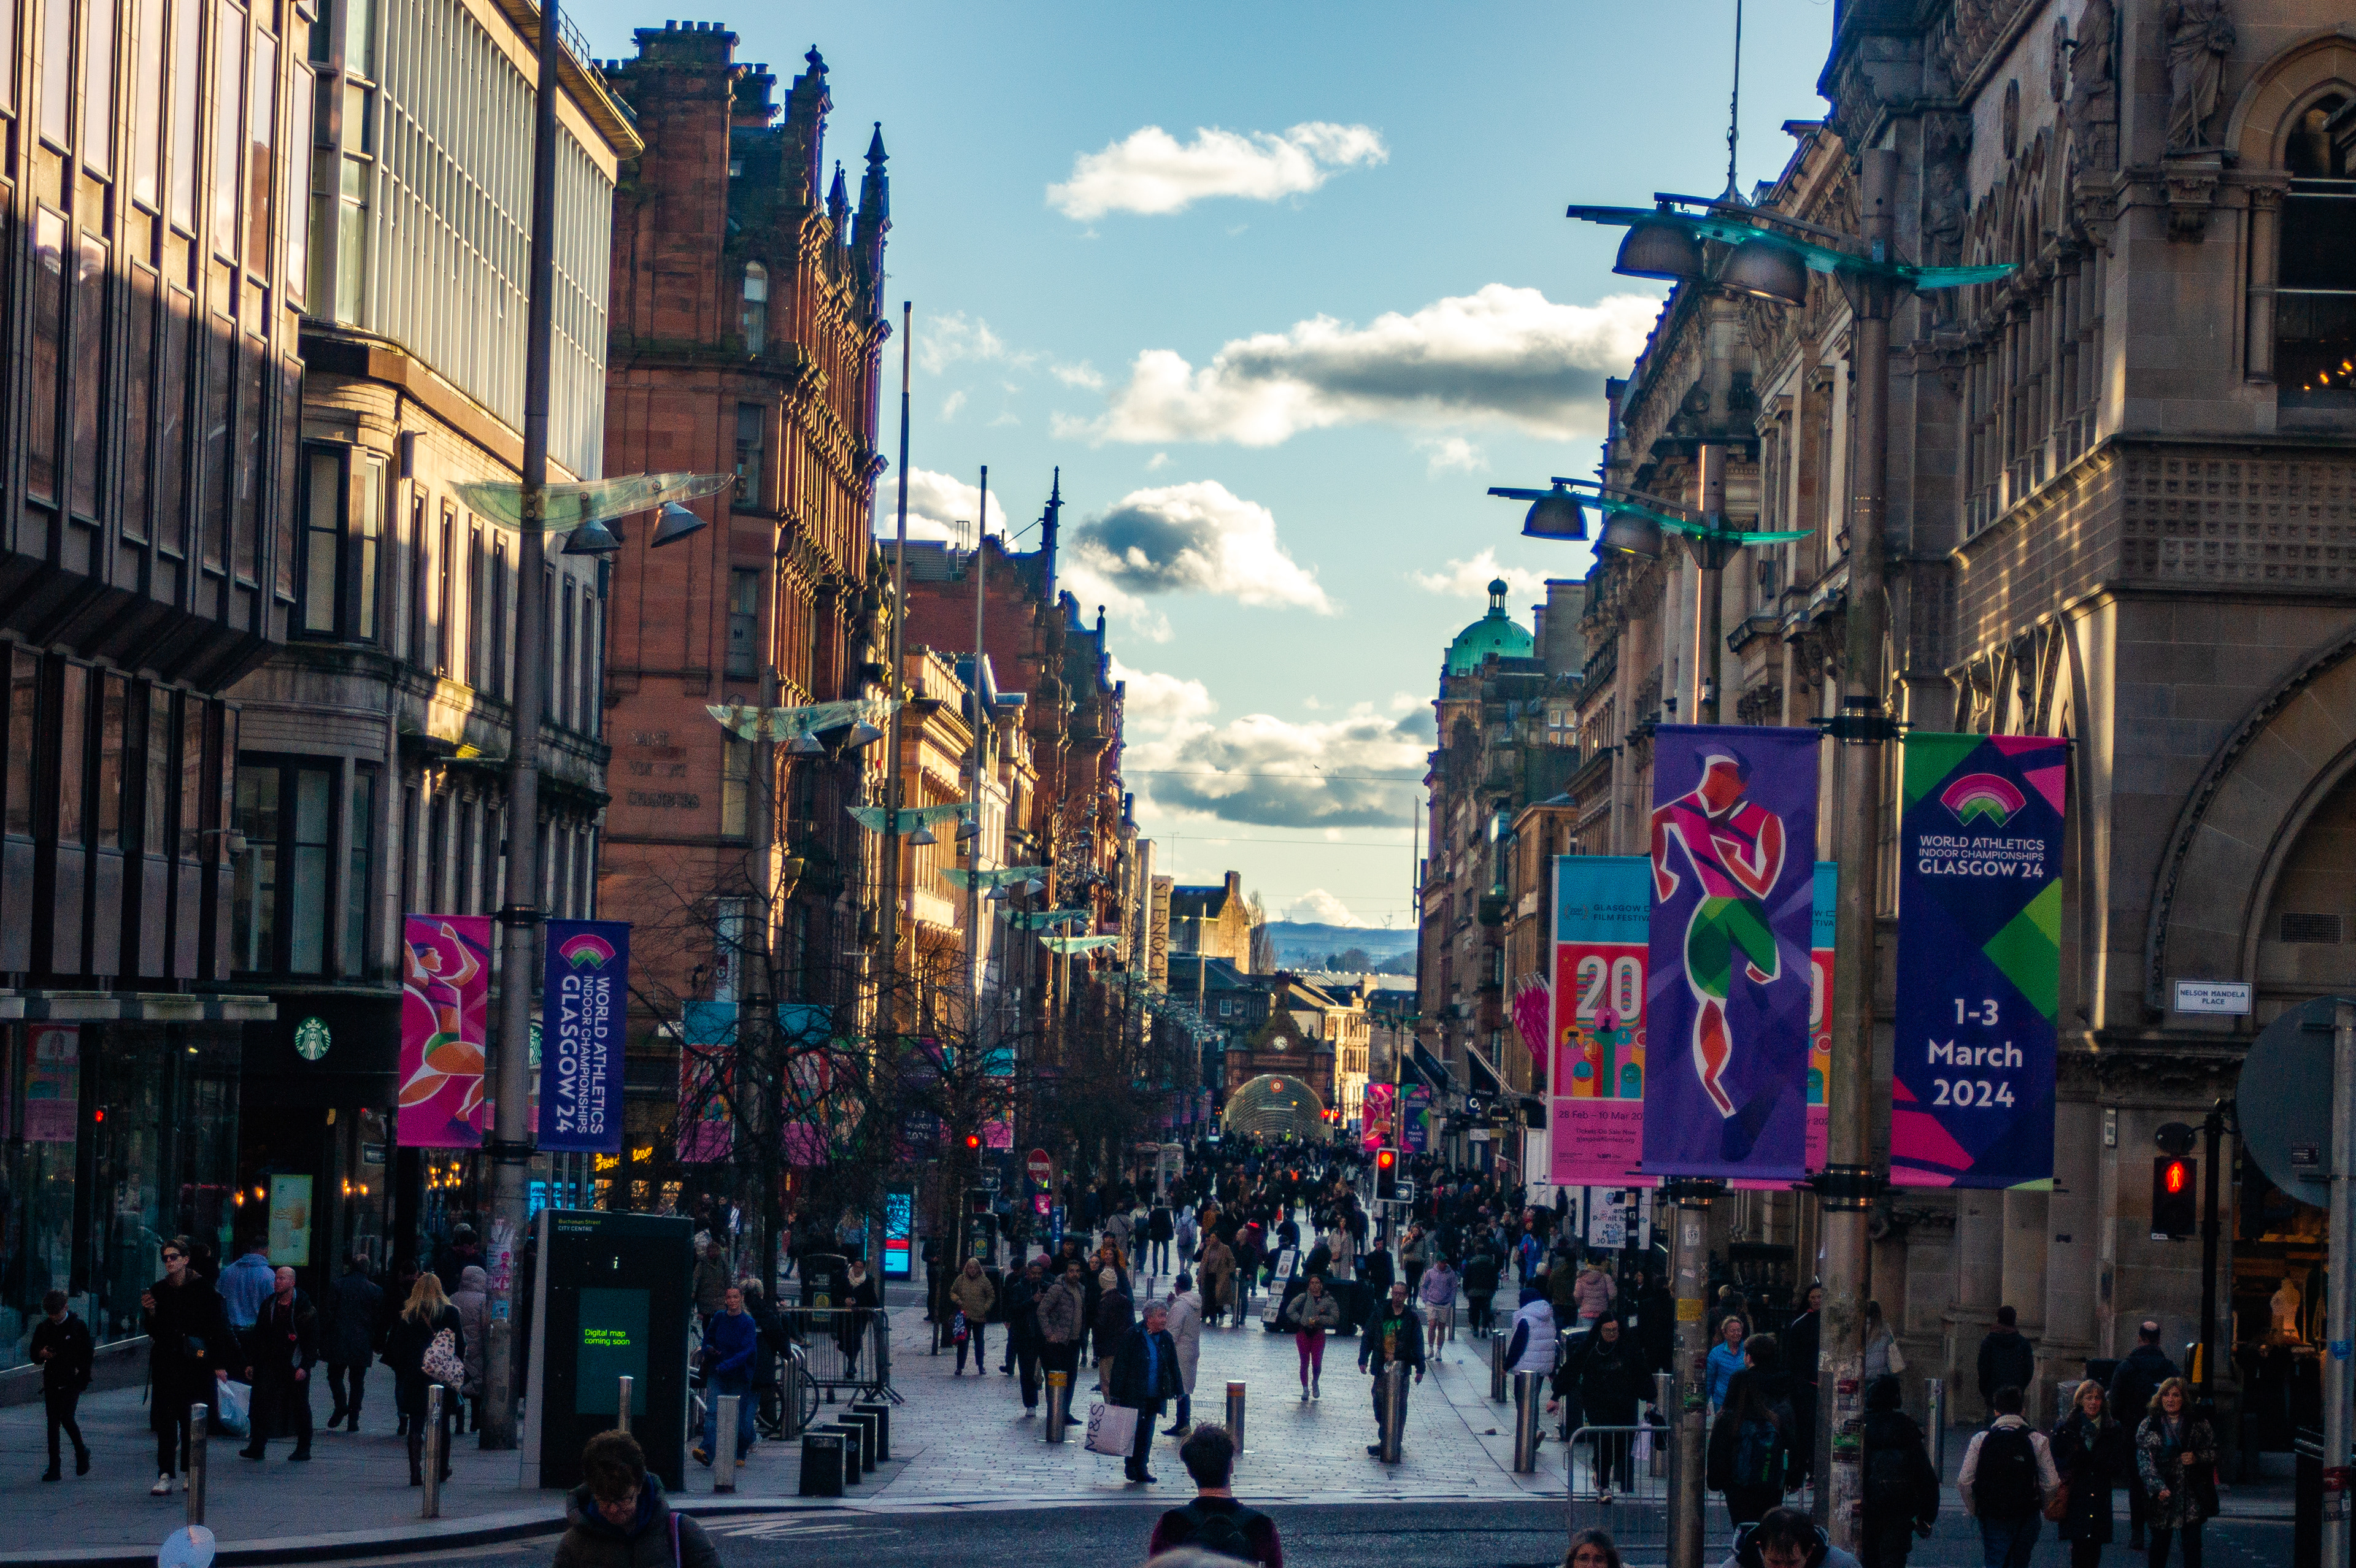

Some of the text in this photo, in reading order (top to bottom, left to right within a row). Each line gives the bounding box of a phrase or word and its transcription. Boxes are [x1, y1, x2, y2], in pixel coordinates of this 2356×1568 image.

[1919, 848, 2044, 861] INDOOR CHAMPIONSHIPS
[1920, 835, 2045, 850] WORLD ATHLETICS
[1919, 860, 2044, 878] GLASGOW 24
[1593, 904, 1641, 912] GLASGOW
[1576, 955, 1643, 1021] 20
[1954, 999, 1999, 1026] 1-3
[556, 975, 580, 1133] GLASGOW 24
[577, 975, 593, 1134] INDOOR CHAMPIONSHIPS
[590, 977, 610, 1134] WORLD ATHLETICS
[1928, 1039, 2023, 1068] March
[1933, 1079, 2015, 1108] 2024
[1572, 1110, 1588, 1119] Feb
[585, 1329, 607, 1337] Digital
[1084, 1404, 1105, 1451] M&S
